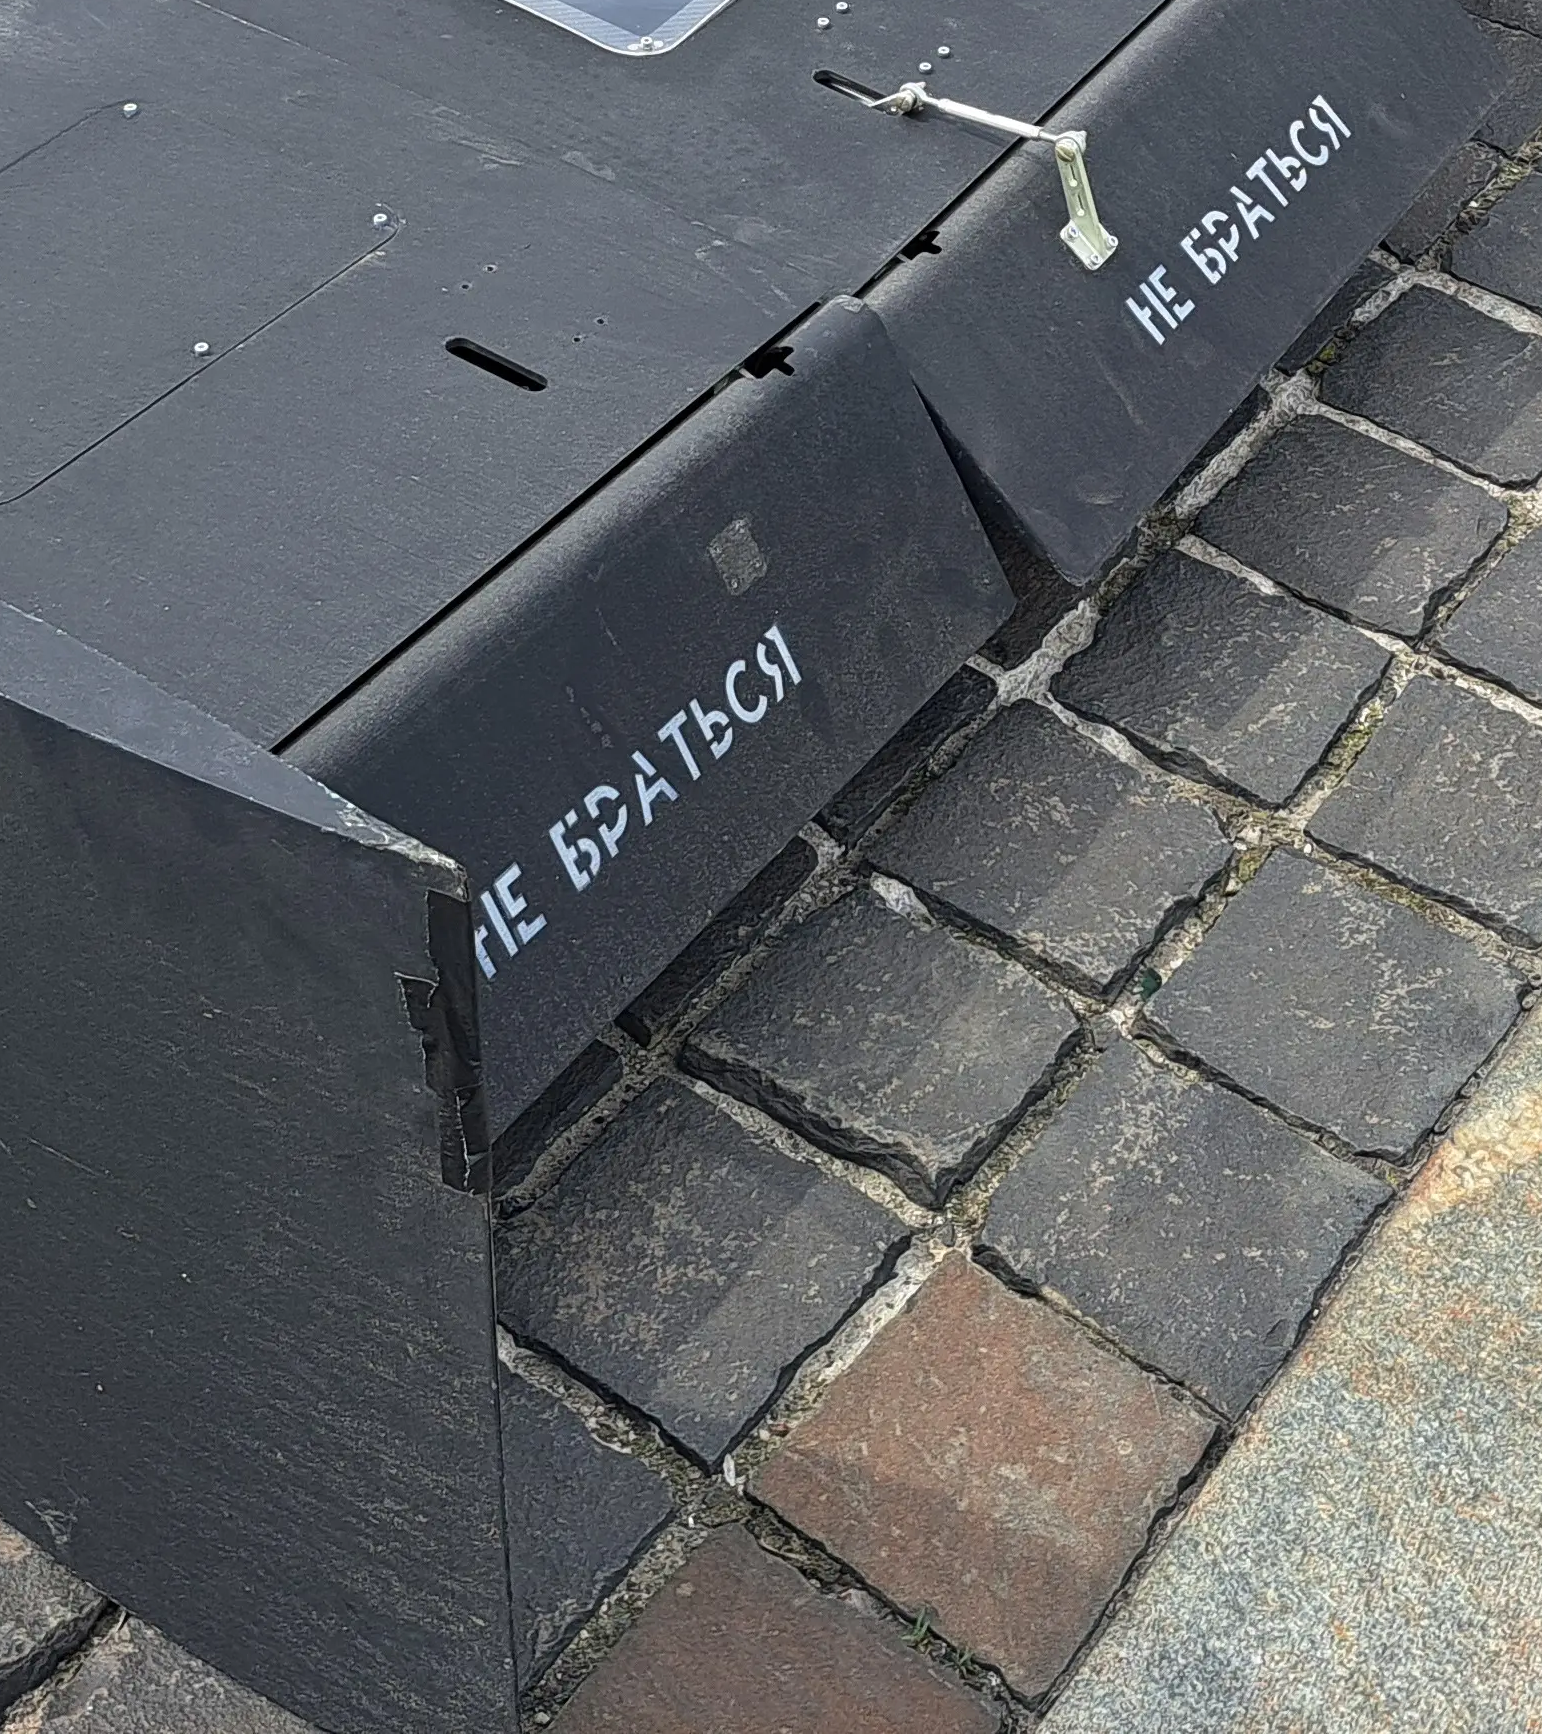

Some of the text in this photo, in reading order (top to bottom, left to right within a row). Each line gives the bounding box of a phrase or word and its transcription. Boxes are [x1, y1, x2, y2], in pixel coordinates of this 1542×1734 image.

[1125, 94, 1351, 345] НЕ БРАТЬСЯ
[548, 625, 802, 892] БРАТЬСЯ
